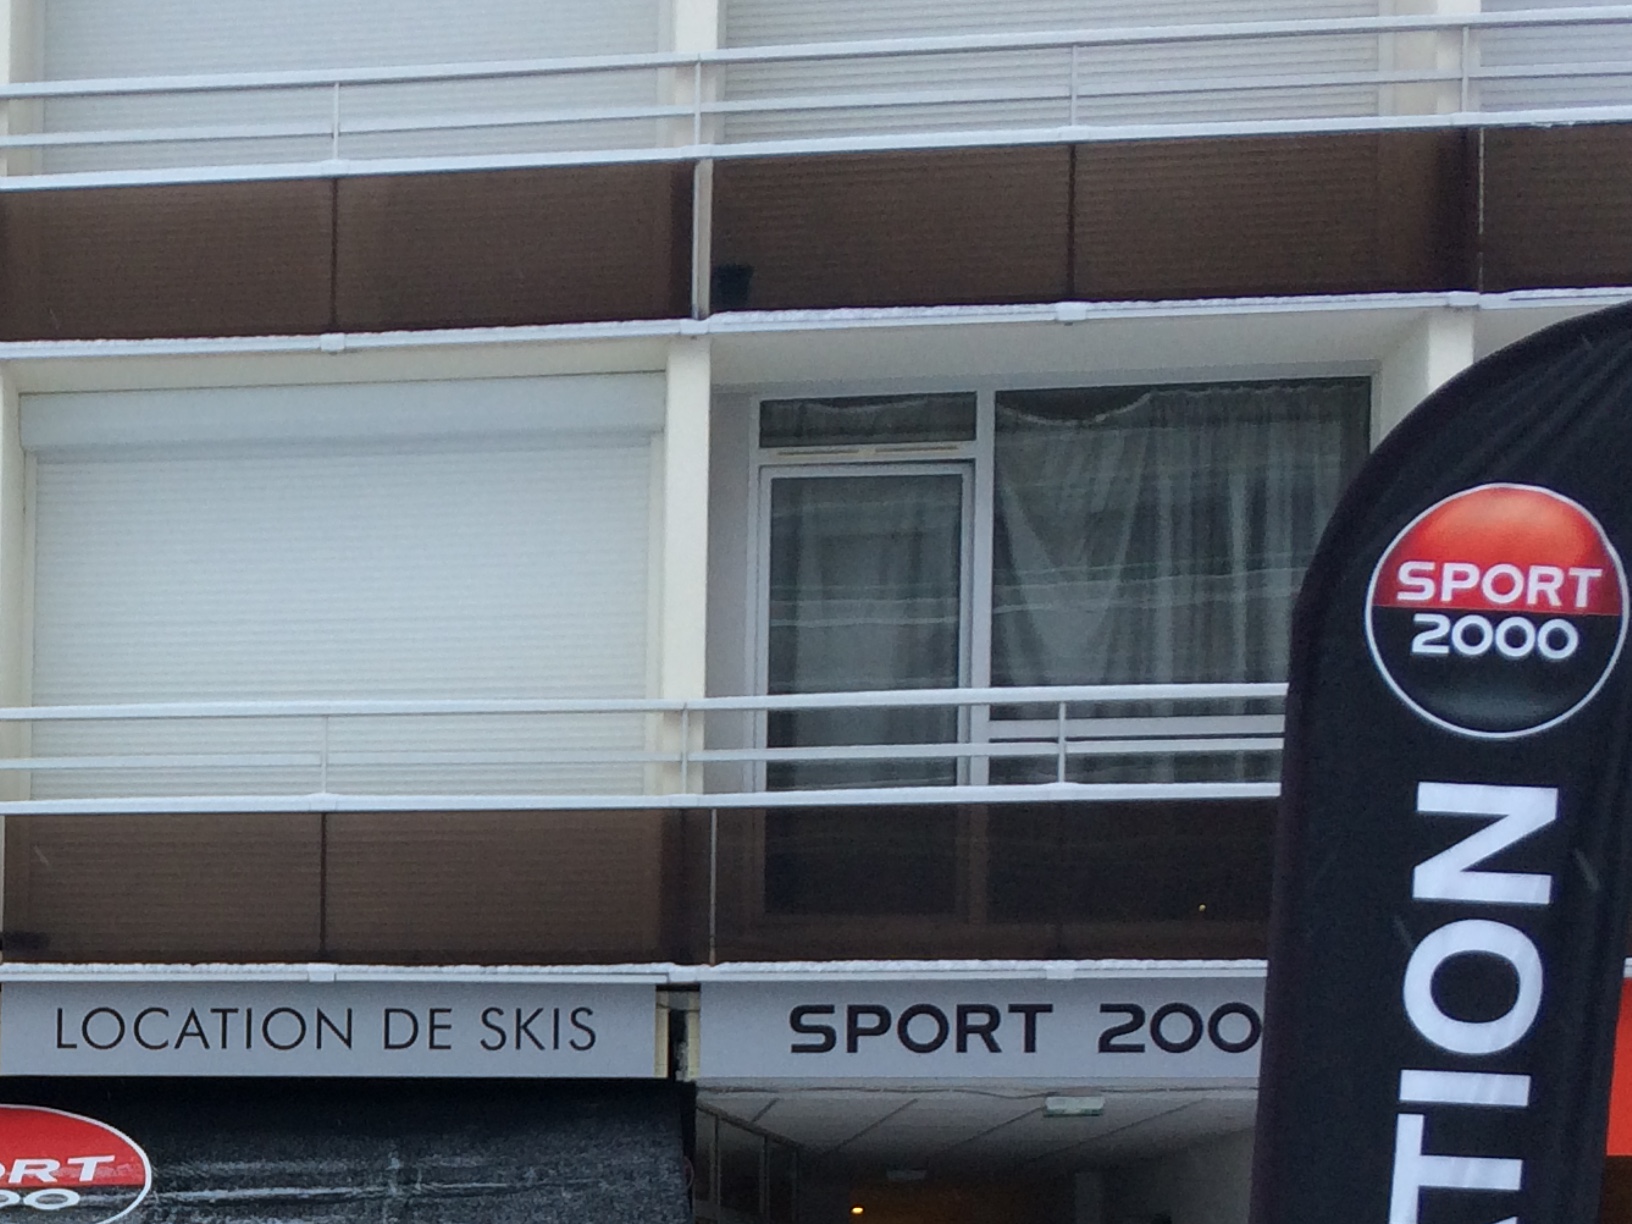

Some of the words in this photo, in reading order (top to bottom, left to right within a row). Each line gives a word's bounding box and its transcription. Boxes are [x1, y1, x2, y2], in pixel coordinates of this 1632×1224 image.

[1396, 561, 1602, 609] SPORT
[1411, 613, 1579, 661] 2000
[56, 1006, 353, 1051] LOCATION
[383, 1008, 454, 1051] DE
[479, 1007, 597, 1052] SKIS
[789, 1003, 1054, 1054] SPORT
[1098, 1002, 1263, 1054] 200
